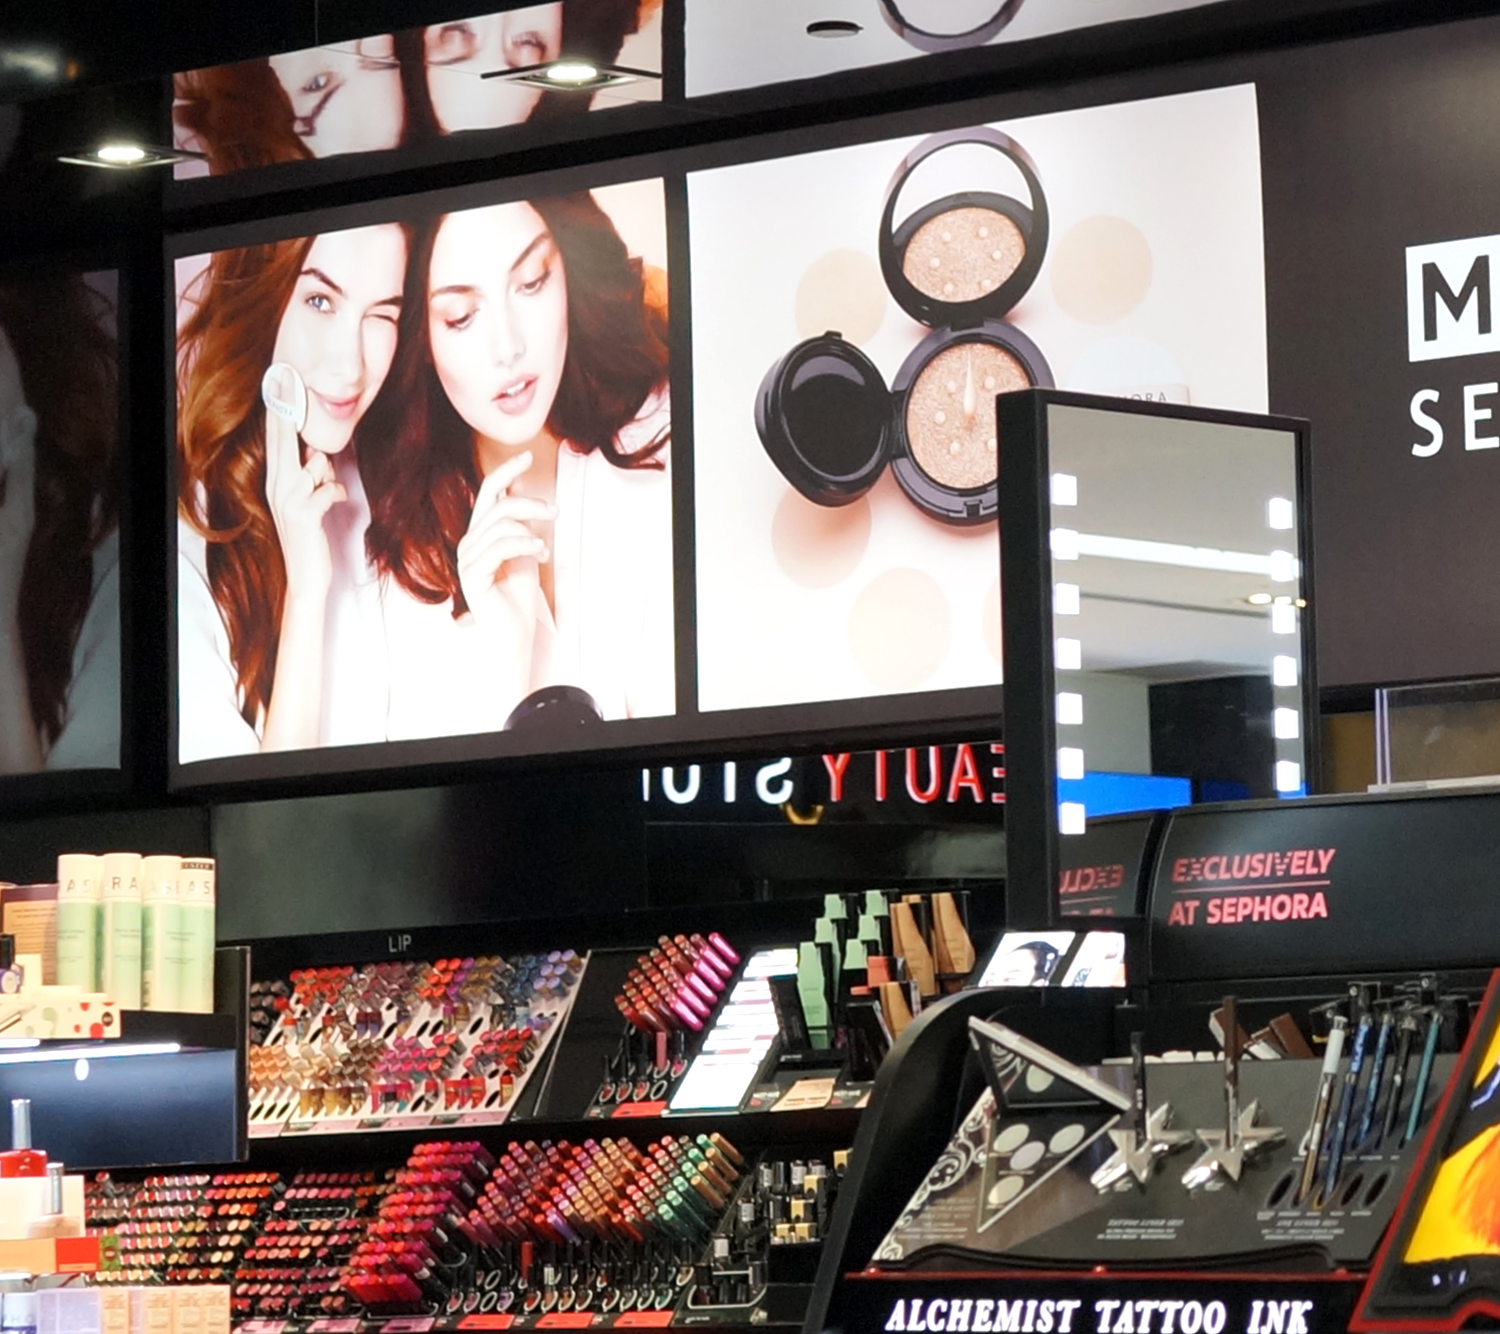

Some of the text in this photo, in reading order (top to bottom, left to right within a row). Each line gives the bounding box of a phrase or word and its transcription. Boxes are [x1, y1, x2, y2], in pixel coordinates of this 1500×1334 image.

[1172, 848, 1336, 883] EXCLUSIVELY
[1167, 891, 1329, 927] AT SEPHORA
[388, 933, 412, 953] LIP
[885, 1298, 1081, 1334] ALCHEMIST
